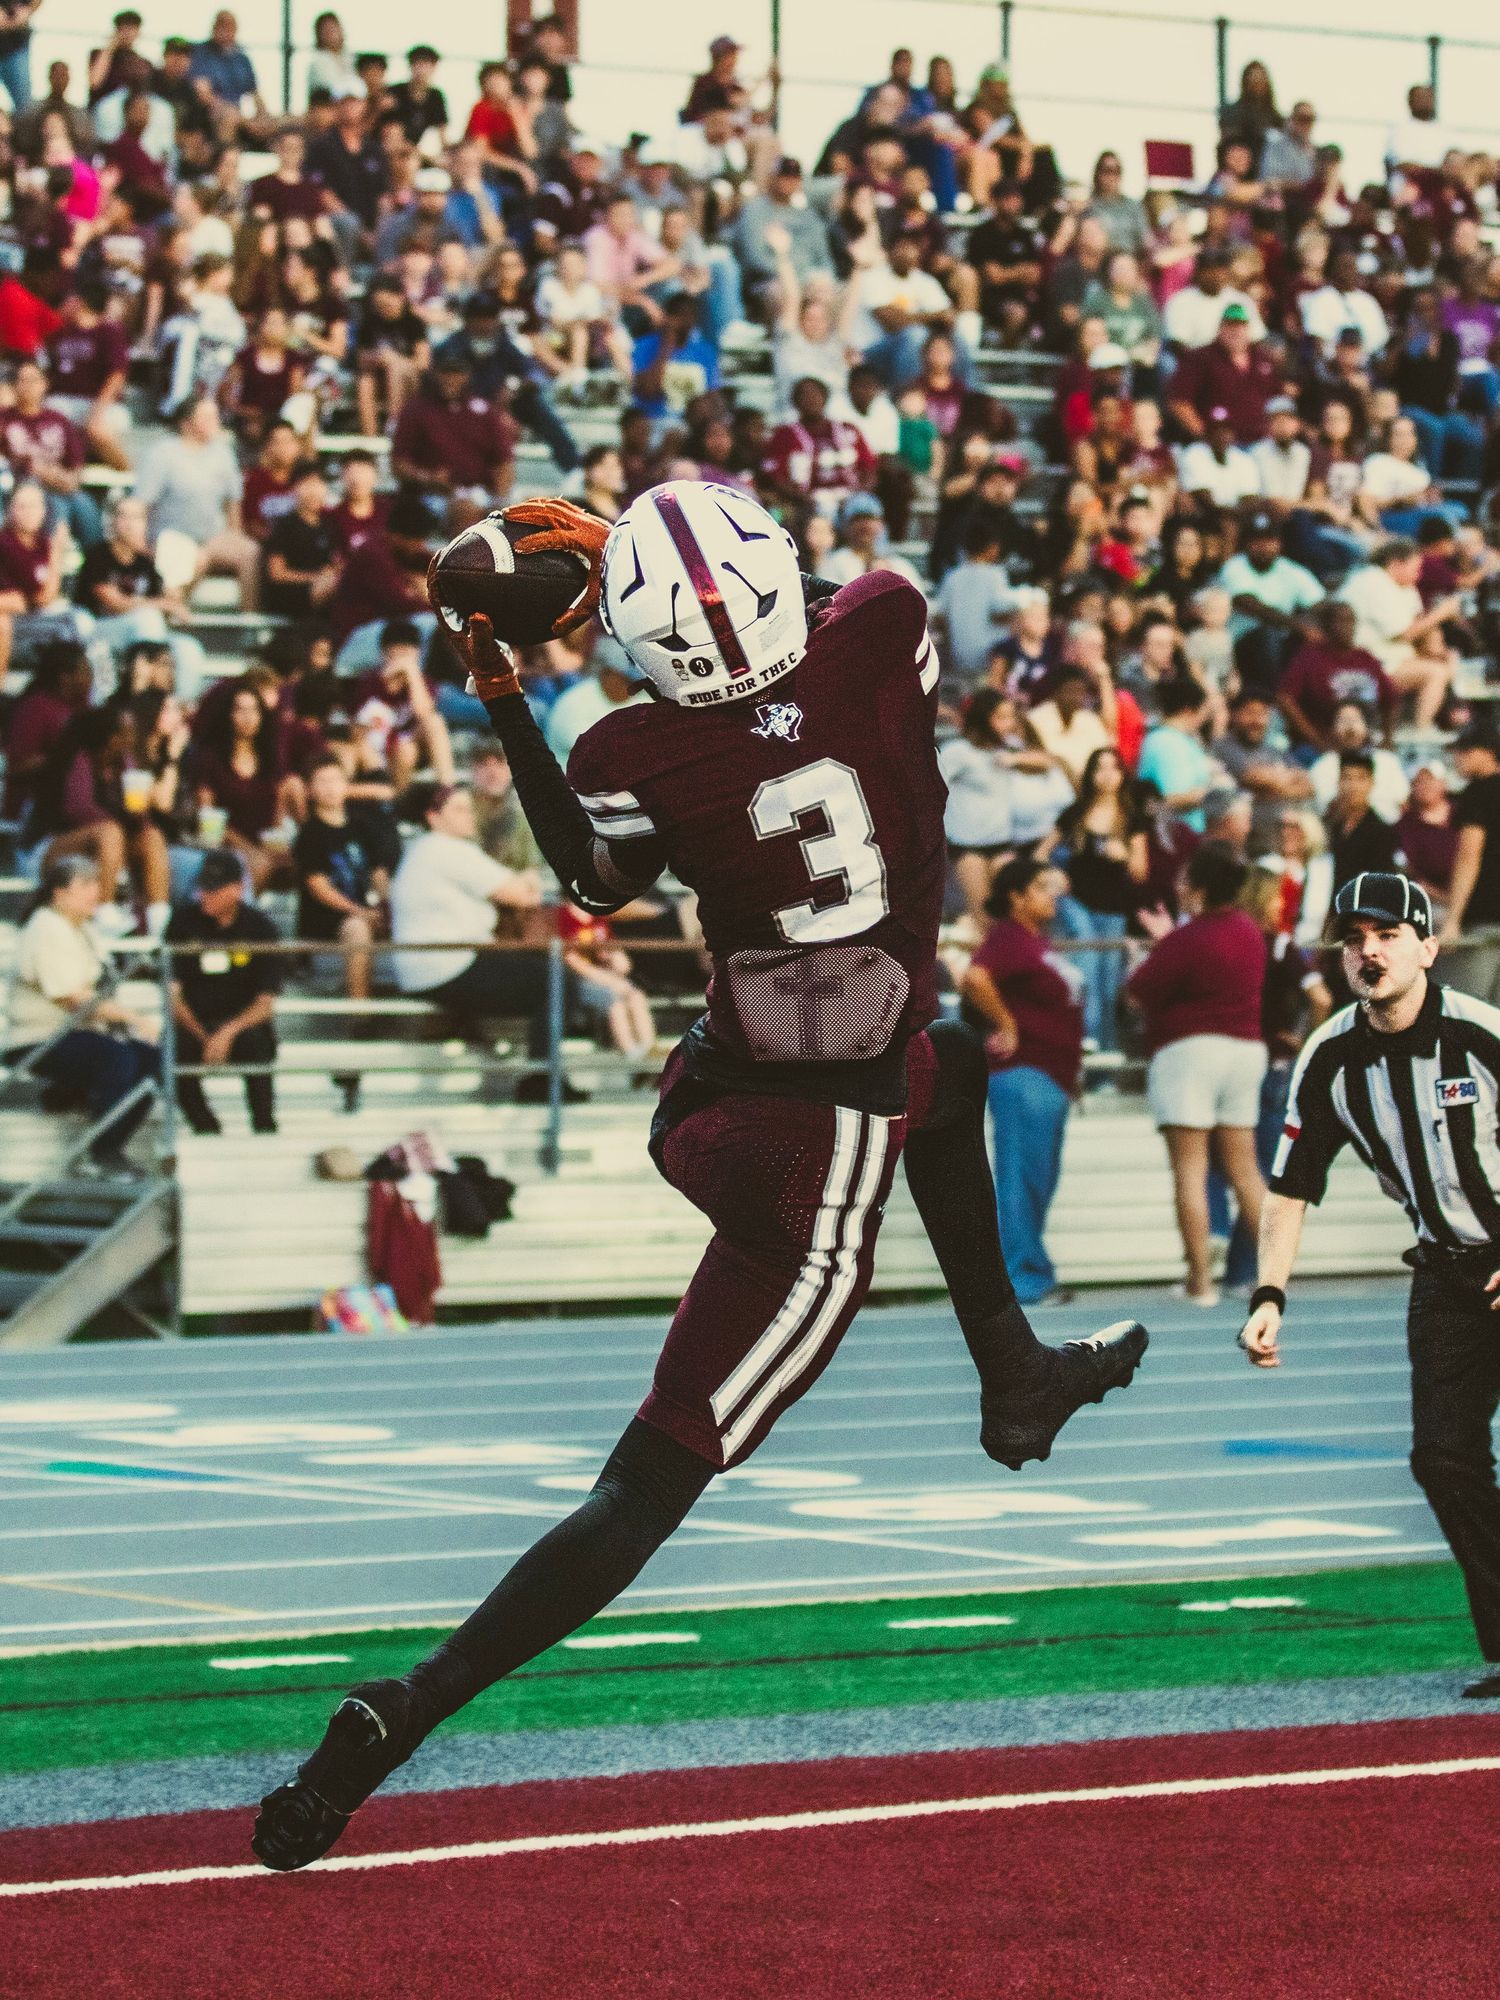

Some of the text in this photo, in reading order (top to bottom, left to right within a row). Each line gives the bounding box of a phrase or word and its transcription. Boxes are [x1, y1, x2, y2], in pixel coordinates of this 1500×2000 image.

[687, 652, 797, 705] RIDE FOR THE C
[696, 660, 706, 675] 3
[746, 757, 890, 943] 3
